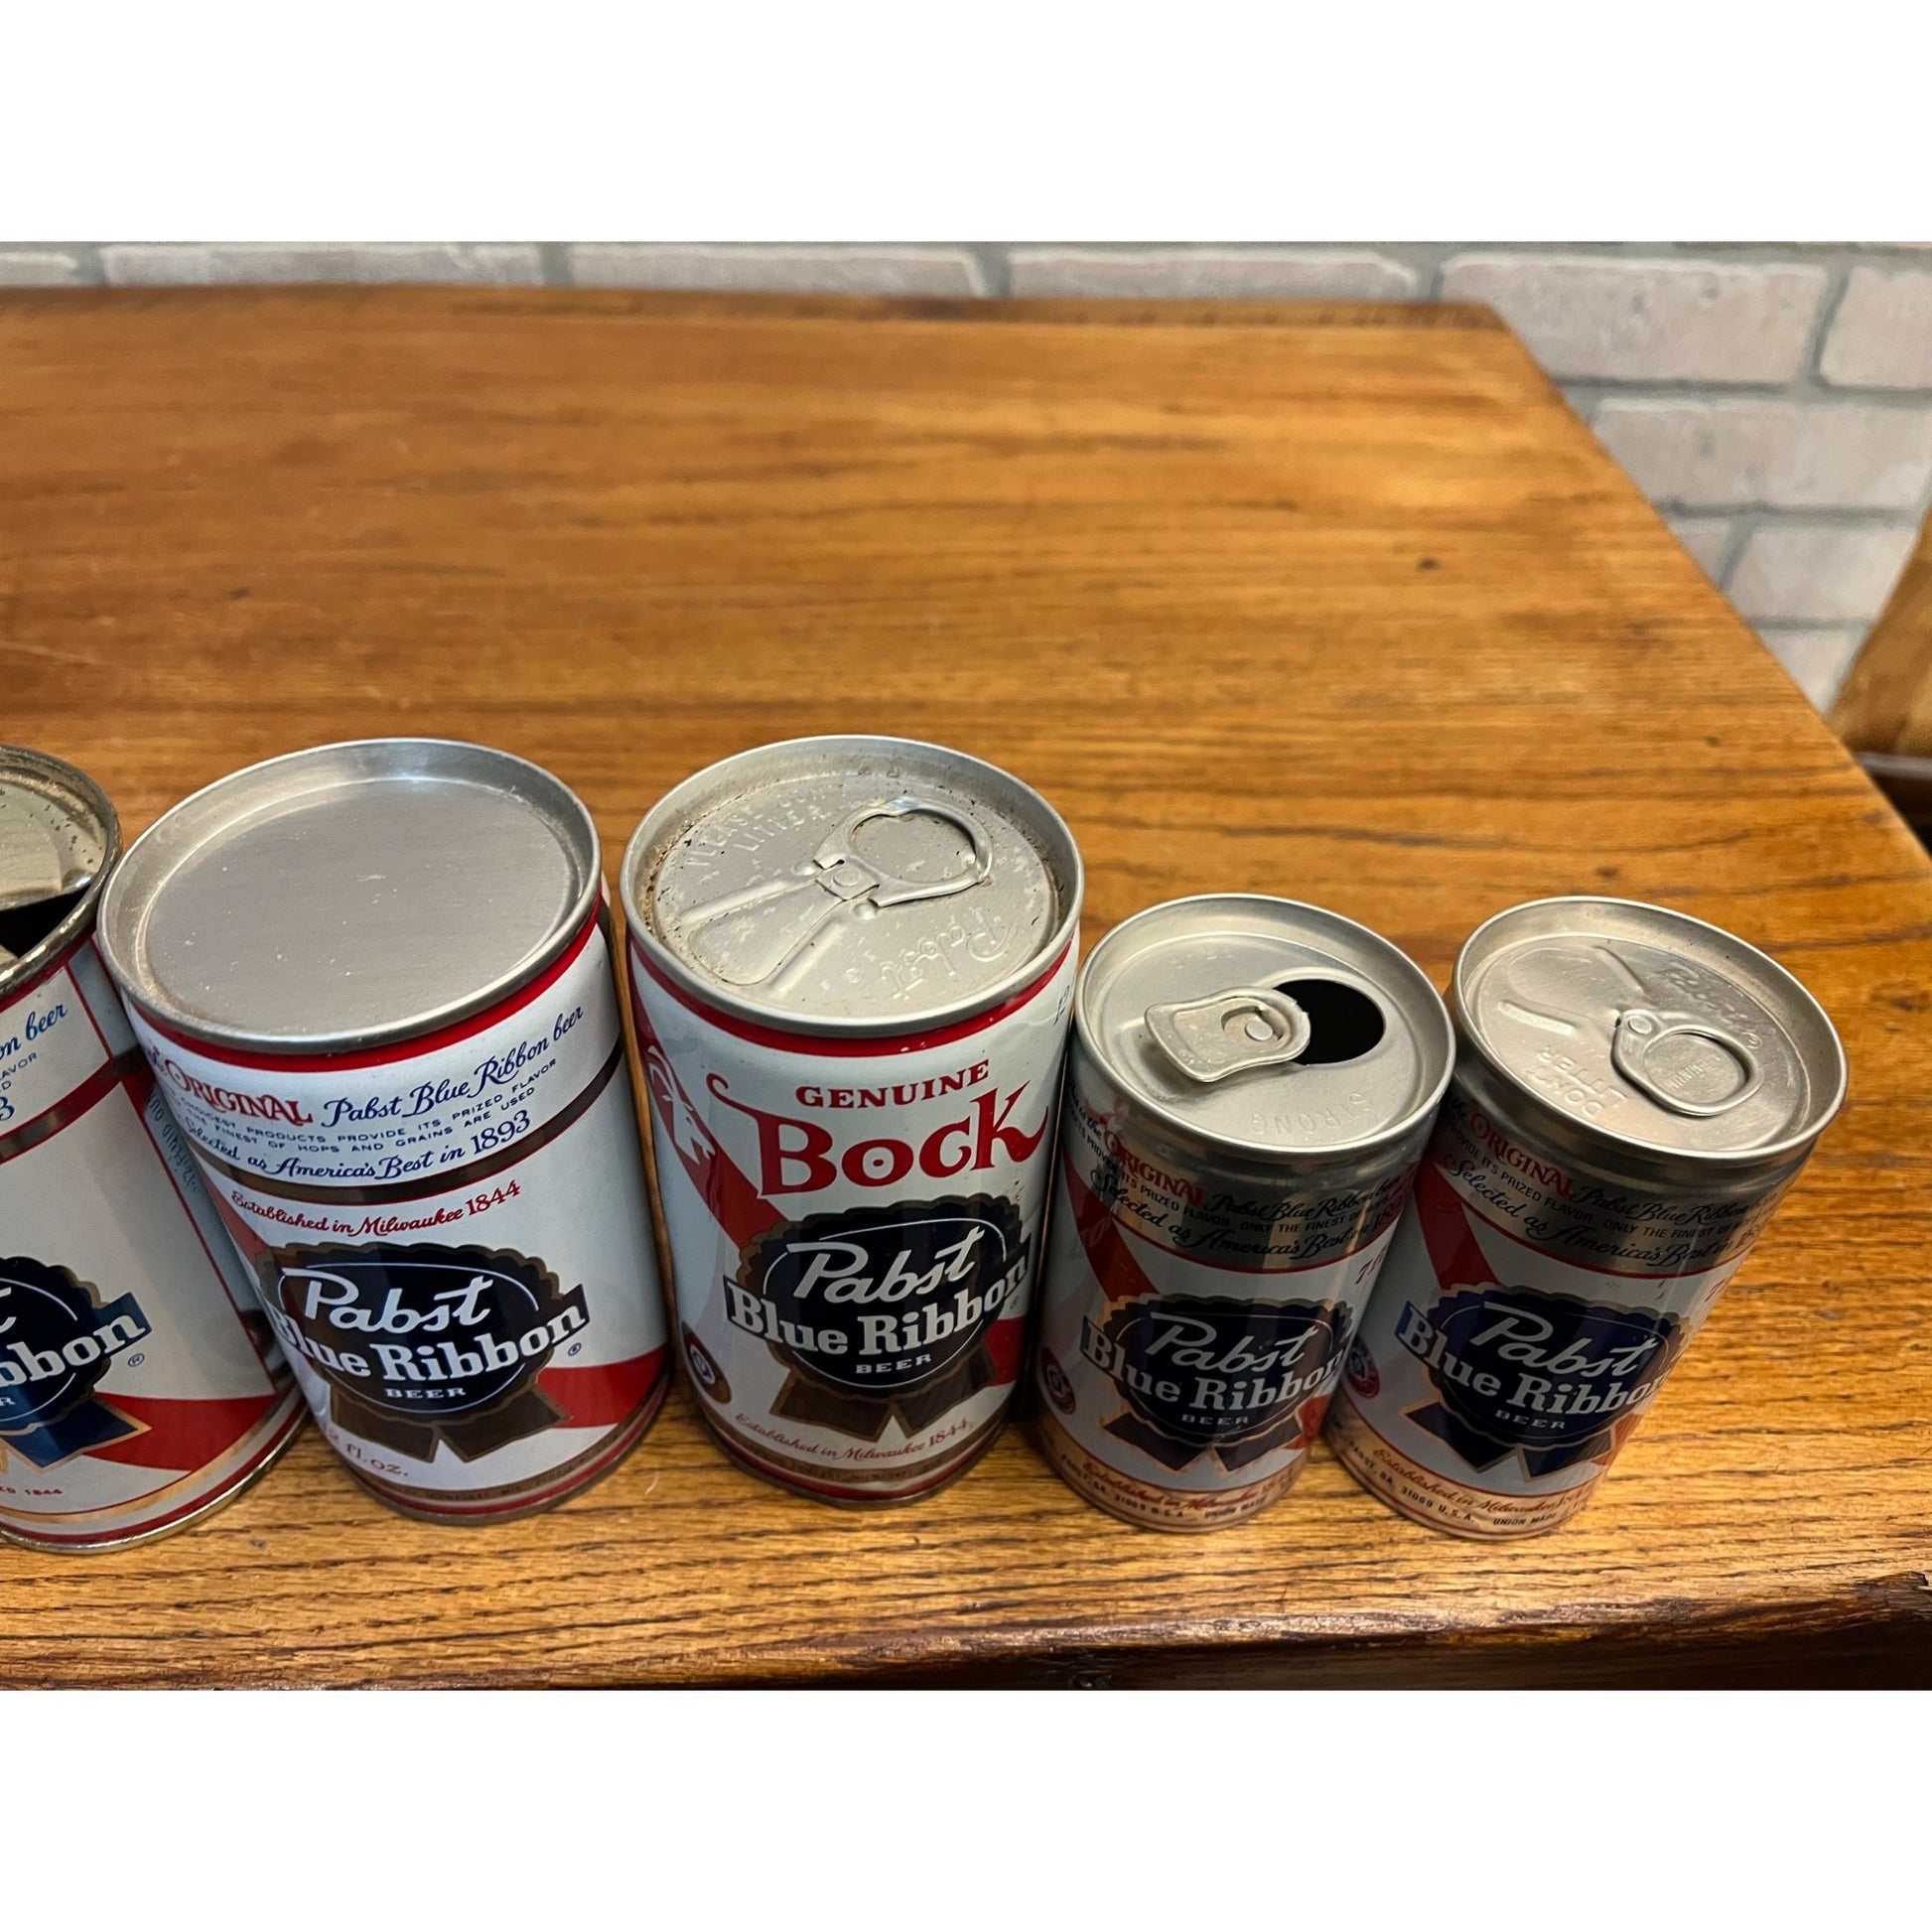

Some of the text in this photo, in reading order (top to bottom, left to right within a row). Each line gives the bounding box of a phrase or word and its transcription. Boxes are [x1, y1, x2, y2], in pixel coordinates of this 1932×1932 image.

[25, 1004, 68, 1040] beer
[0, 1052, 37, 1079] AVOR
[165, 1059, 313, 1126] ORIGINAL
[321, 1096, 403, 1128] Pabst
[401, 1079, 471, 1118] Blue
[467, 1036, 549, 1098] Ribbon
[553, 1006, 584, 1041] beer
[795, 1059, 990, 1109] GENUINE
[1536, 1044, 1631, 1107] LITTER
[214, 1123, 258, 1145] FINEST
[268, 1141, 285, 1150] OF
[298, 1144, 340, 1153] HOPS
[351, 1143, 384, 1153] AND
[395, 1126, 453, 1147] GRAINS
[464, 1111, 491, 1128] ARE
[501, 1086, 535, 1111] USED
[246, 1126, 327, 1143] PRODUCTS
[337, 1128, 406, 1143] PROVIDE
[417, 1119, 442, 1131] ITS
[452, 1094, 503, 1121] PRIZED
[512, 1058, 557, 1093] FLAVOR
[186, 1109, 531, 1180] Selected as America's Best in 1893
[1103, 1130, 1209, 1208] ORIGINAL
[1258, 1200, 1314, 1221] Blue
[1470, 1112, 1576, 1197] ORIGINAL
[1571, 1185, 1640, 1218] Pabst
[1627, 1202, 1687, 1222] Blue
[231, 1179, 521, 1236] Established in Milwaukee 1844
[1090, 1170, 1169, 1228] Selected
[1173, 1229, 1301, 1255] America's
[1289, 1229, 1353, 1260] Best
[1121, 1173, 1138, 1188] ITS
[1141, 1185, 1179, 1212] PRIZED
[1279, 1223, 1302, 1233] THE
[1305, 1217, 1345, 1232] FINEST
[1444, 1153, 1527, 1218] Selected
[1481, 1157, 1499, 1174] ITS
[1500, 1172, 1542, 1202] PRIZED
[1545, 1196, 1594, 1224] FLAVOR
[1603, 1218, 1638, 1234] ONLY
[1642, 1225, 1668, 1239] THE
[1524, 1214, 1548, 1235] as
[1527, 1225, 1663, 1262] America's
[1646, 1242, 1718, 1268] Best
[785, 1226, 985, 1304] Pabst
[281, 1267, 494, 1333] Pabst
[729, 1253, 1028, 1357] Blue Ribbon
[264, 1296, 587, 1381] Blue Ribbon
[856, 1353, 932, 1374] BEER
[1082, 1322, 1344, 1411] Blue Ribbon
[1145, 1311, 1319, 1374] Pabst
[1398, 1309, 1671, 1416] Blue Ribbon
[1470, 1301, 1659, 1378] Pabst
[385, 1387, 467, 1399] BEER
[1181, 1414, 1249, 1426] BEER
[1494, 1408, 1567, 1431] BEER
[735, 1412, 968, 1461] Established in Milwaukee 1844
[1373, 1449, 1458, 1500] Established
[1492, 1517, 1527, 1526] UNION
